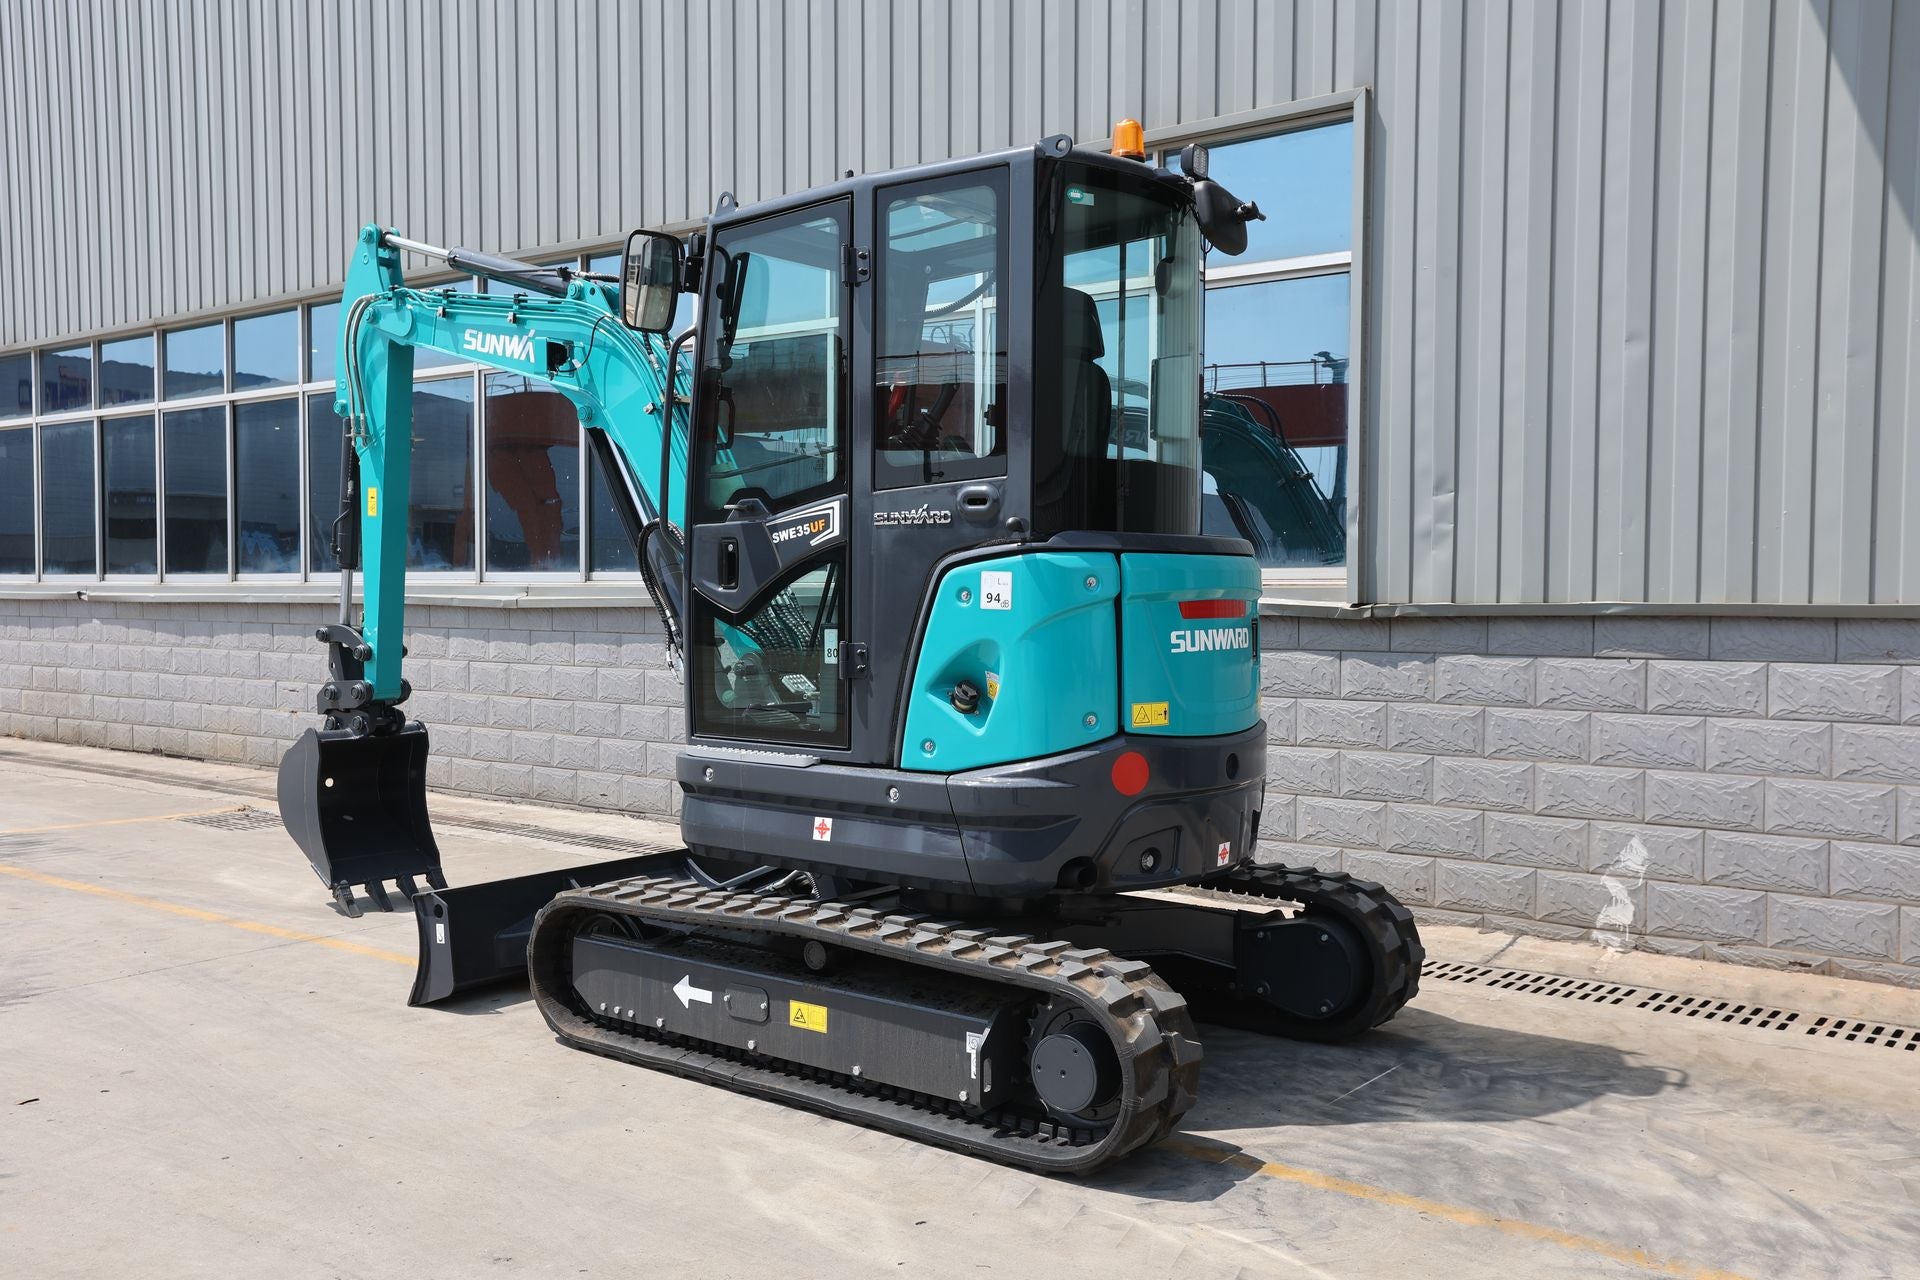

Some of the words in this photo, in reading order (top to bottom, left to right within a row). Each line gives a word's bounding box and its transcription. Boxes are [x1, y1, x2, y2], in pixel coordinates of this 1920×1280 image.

[463, 328, 536, 363] SUNWA
[873, 503, 952, 526] SUNWARD
[772, 519, 825, 544] SWE35UF
[986, 592, 1001, 603] 94
[1170, 627, 1249, 653] SUNWARD
